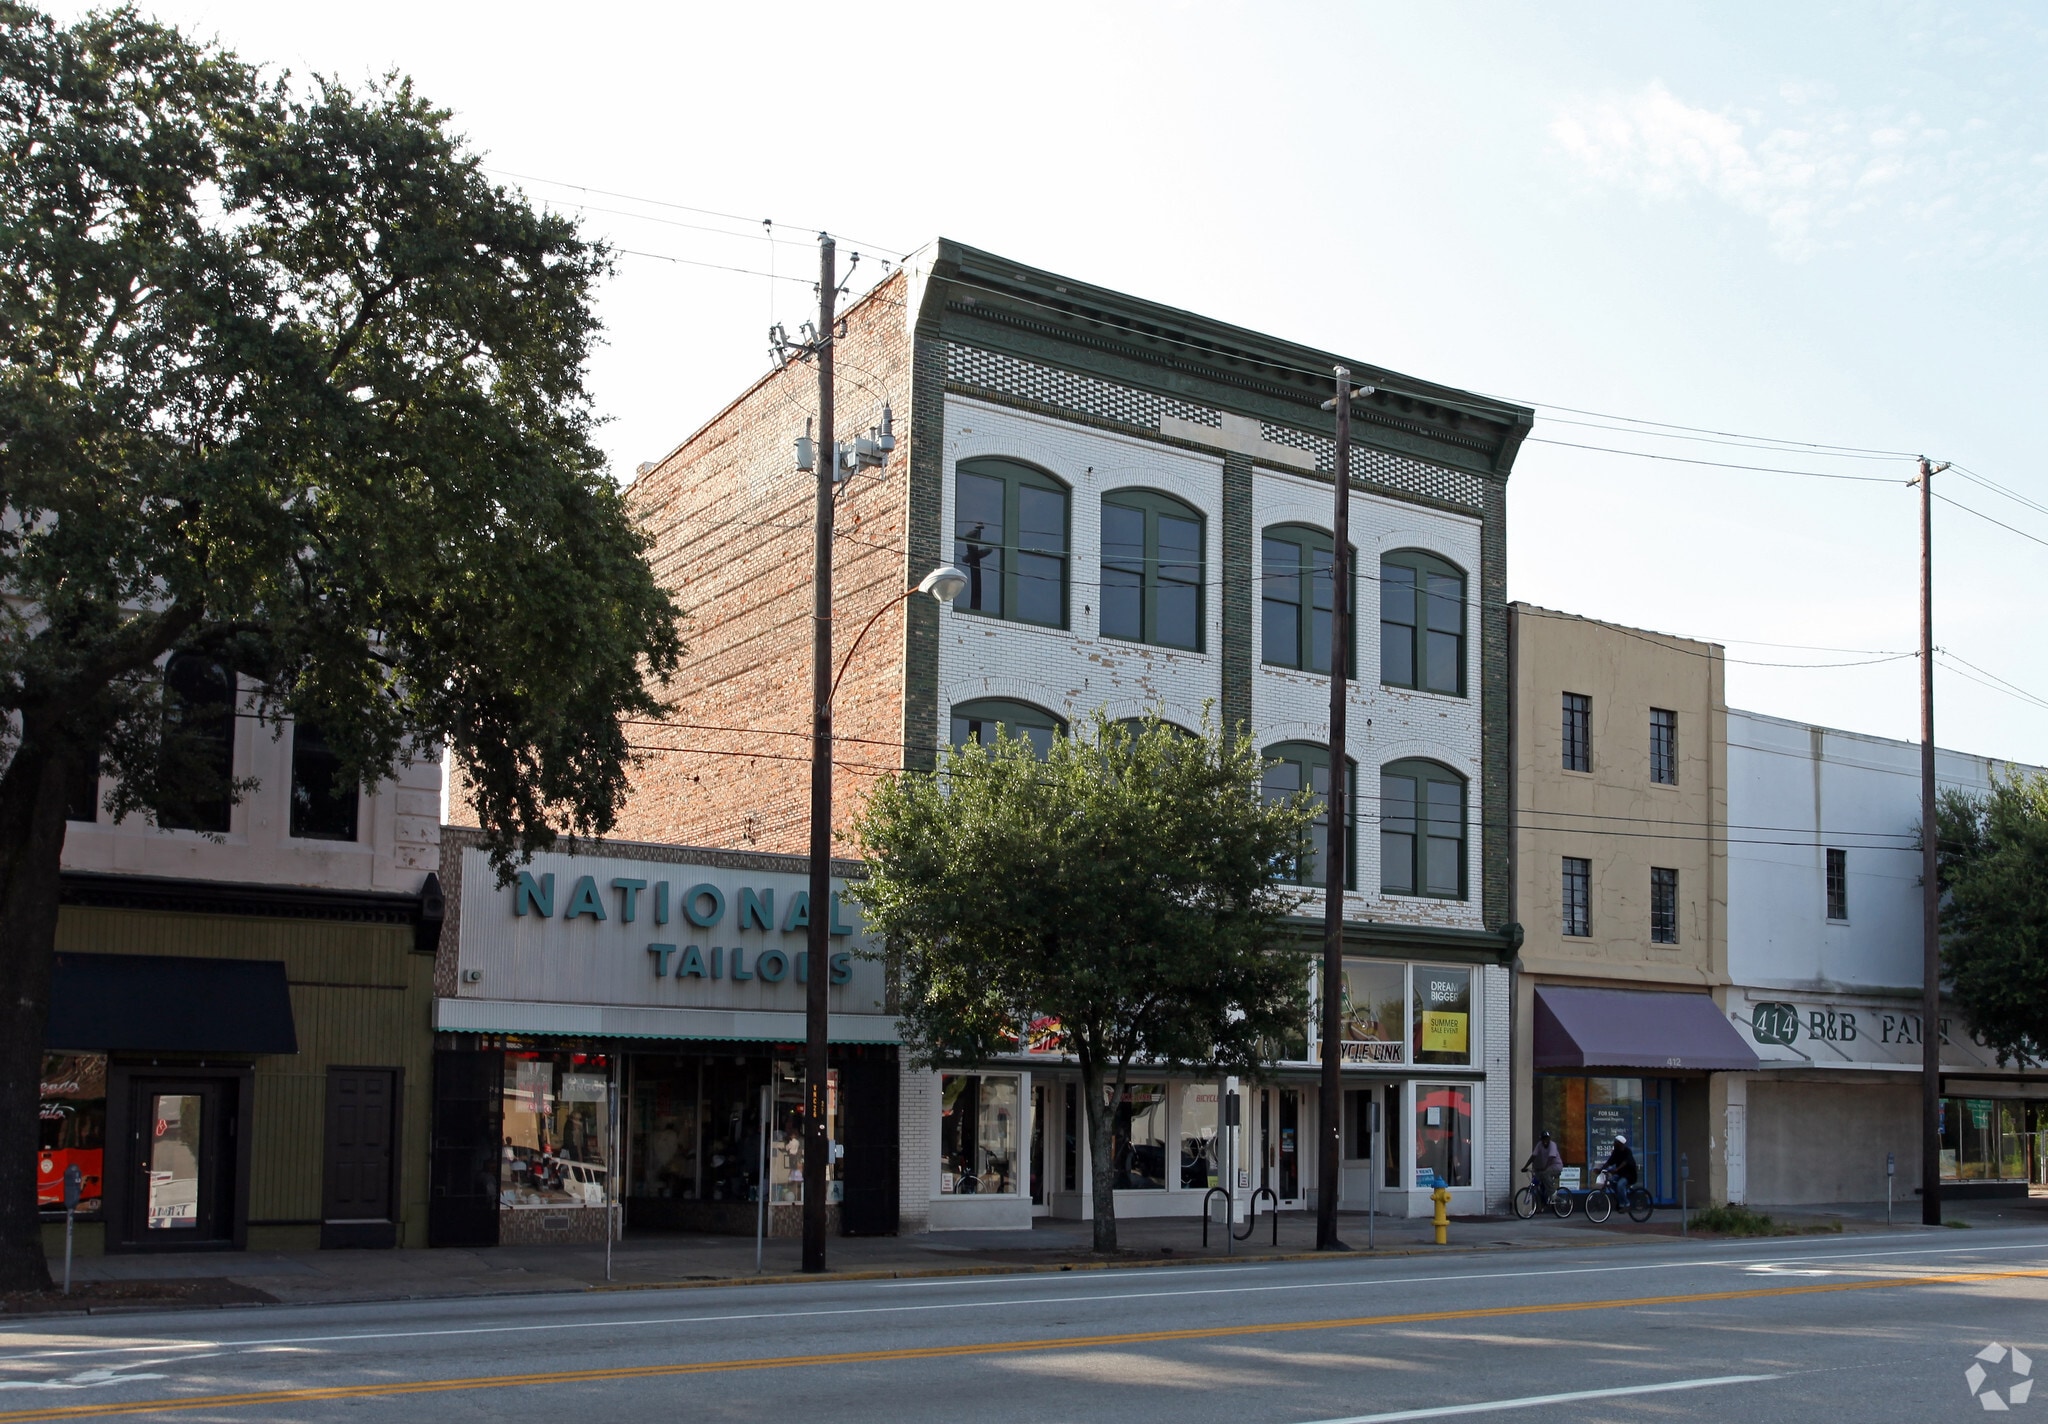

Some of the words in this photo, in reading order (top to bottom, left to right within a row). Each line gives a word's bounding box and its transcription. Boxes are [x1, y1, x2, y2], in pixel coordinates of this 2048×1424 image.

[514, 871, 853, 935] NATIONAL
[1430, 980, 1459, 992] DREAM
[1430, 991, 1458, 1002] BIGGER
[1430, 1018, 1459, 1028] SUMMER
[1756, 1010, 1794, 1040] 414
[1808, 1011, 1857, 1042] B&B
[1443, 1027, 1459, 1035] EVENT
[1373, 1044, 1402, 1061] LINK
[1666, 1057, 1682, 1067] 412
[1196, 1094, 1218, 1103] BICYCL
